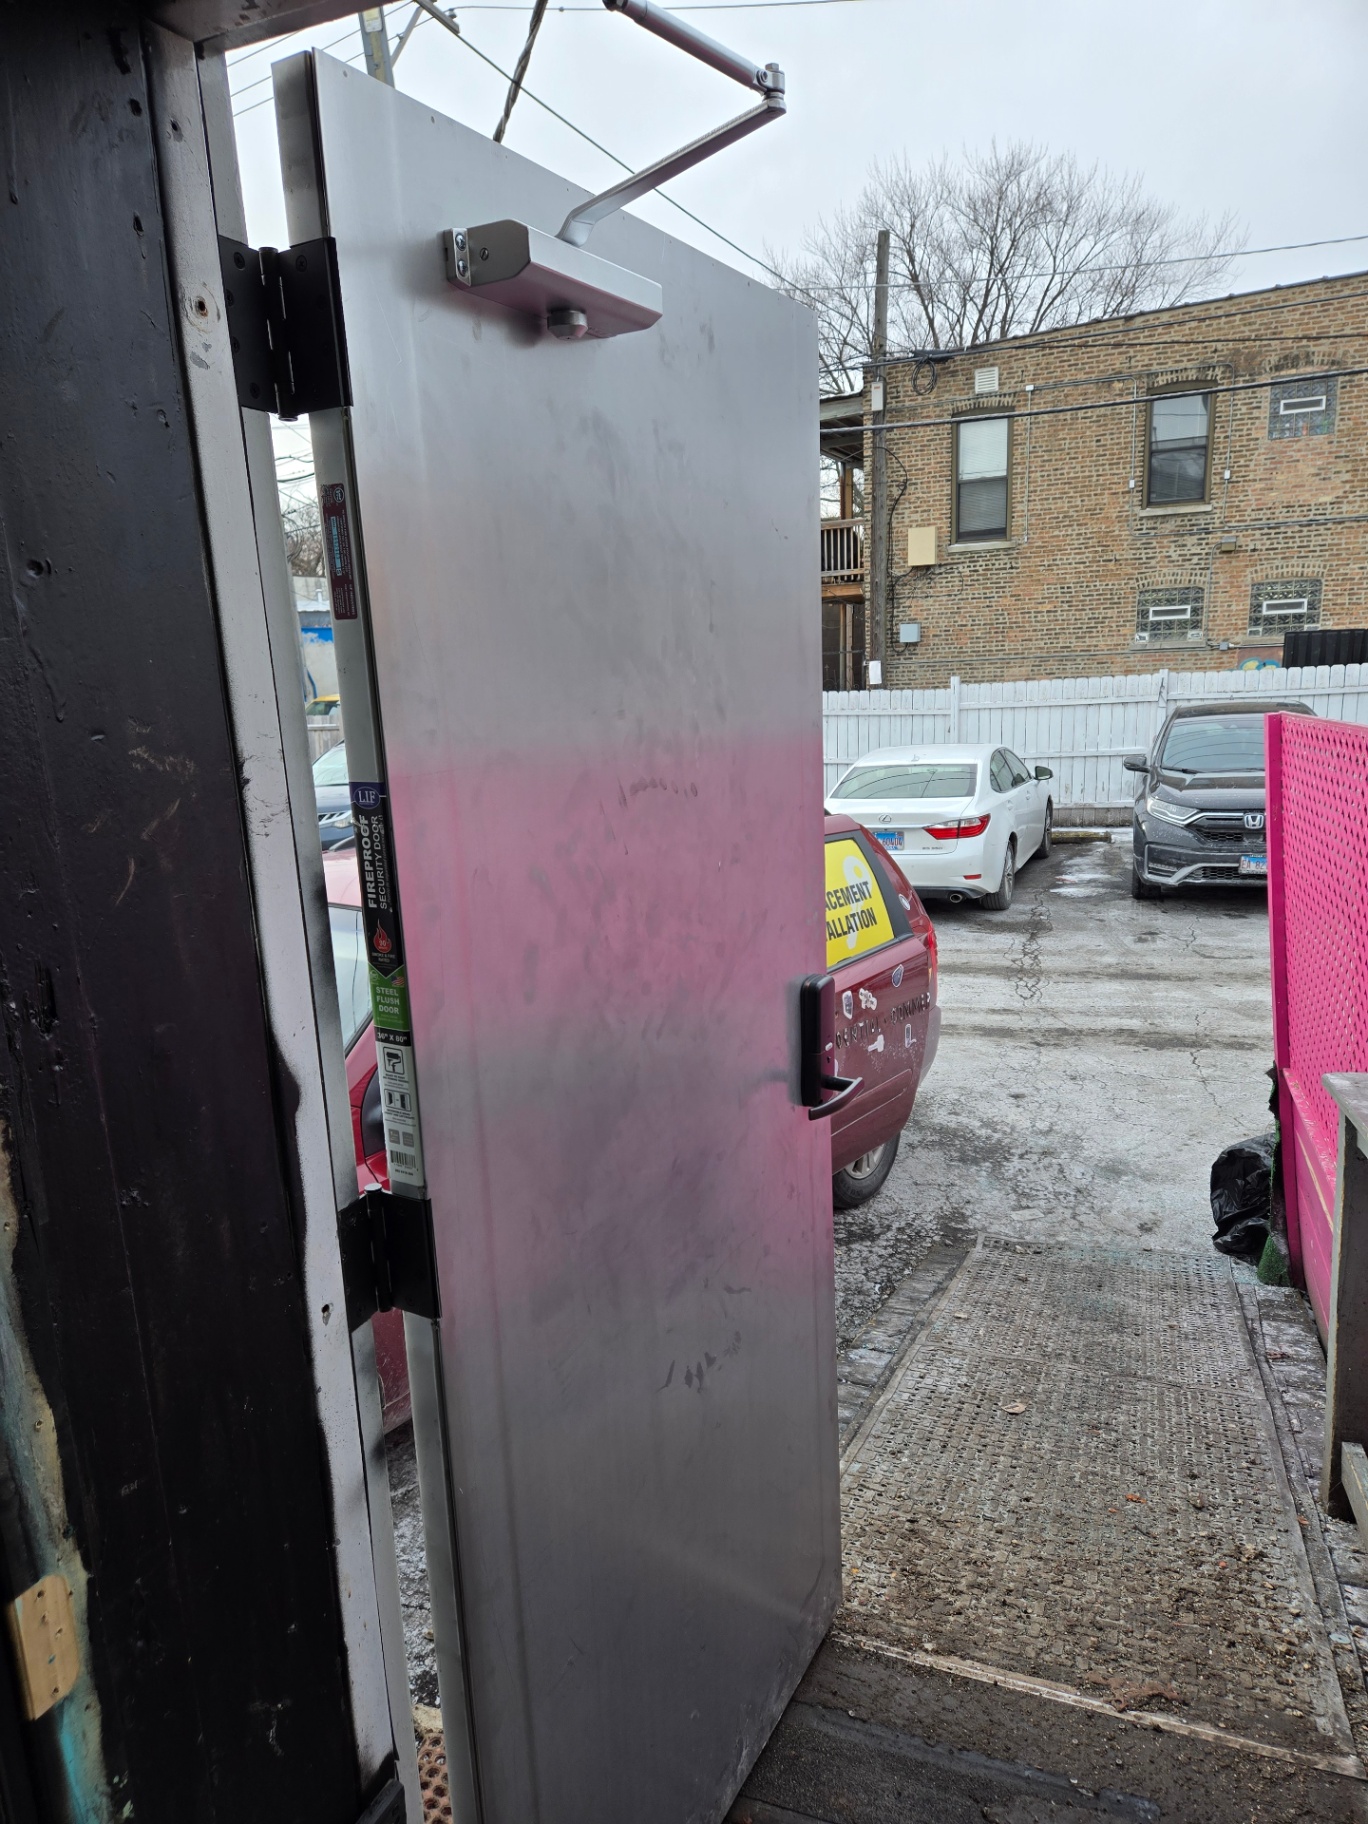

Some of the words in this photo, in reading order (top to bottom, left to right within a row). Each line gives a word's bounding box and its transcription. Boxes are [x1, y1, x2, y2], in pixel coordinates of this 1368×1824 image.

[358, 790, 376, 803] LIF
[371, 815, 381, 849] DOOR
[359, 814, 377, 909] FIREPROOF
[374, 852, 388, 909] SECURITY
[826, 907, 877, 941] ALLATION
[376, 987, 399, 997] STEEL
[376, 996, 400, 1006] FLUSH
[378, 1004, 400, 1015] DOOR
[389, 1033, 394, 1041] X
